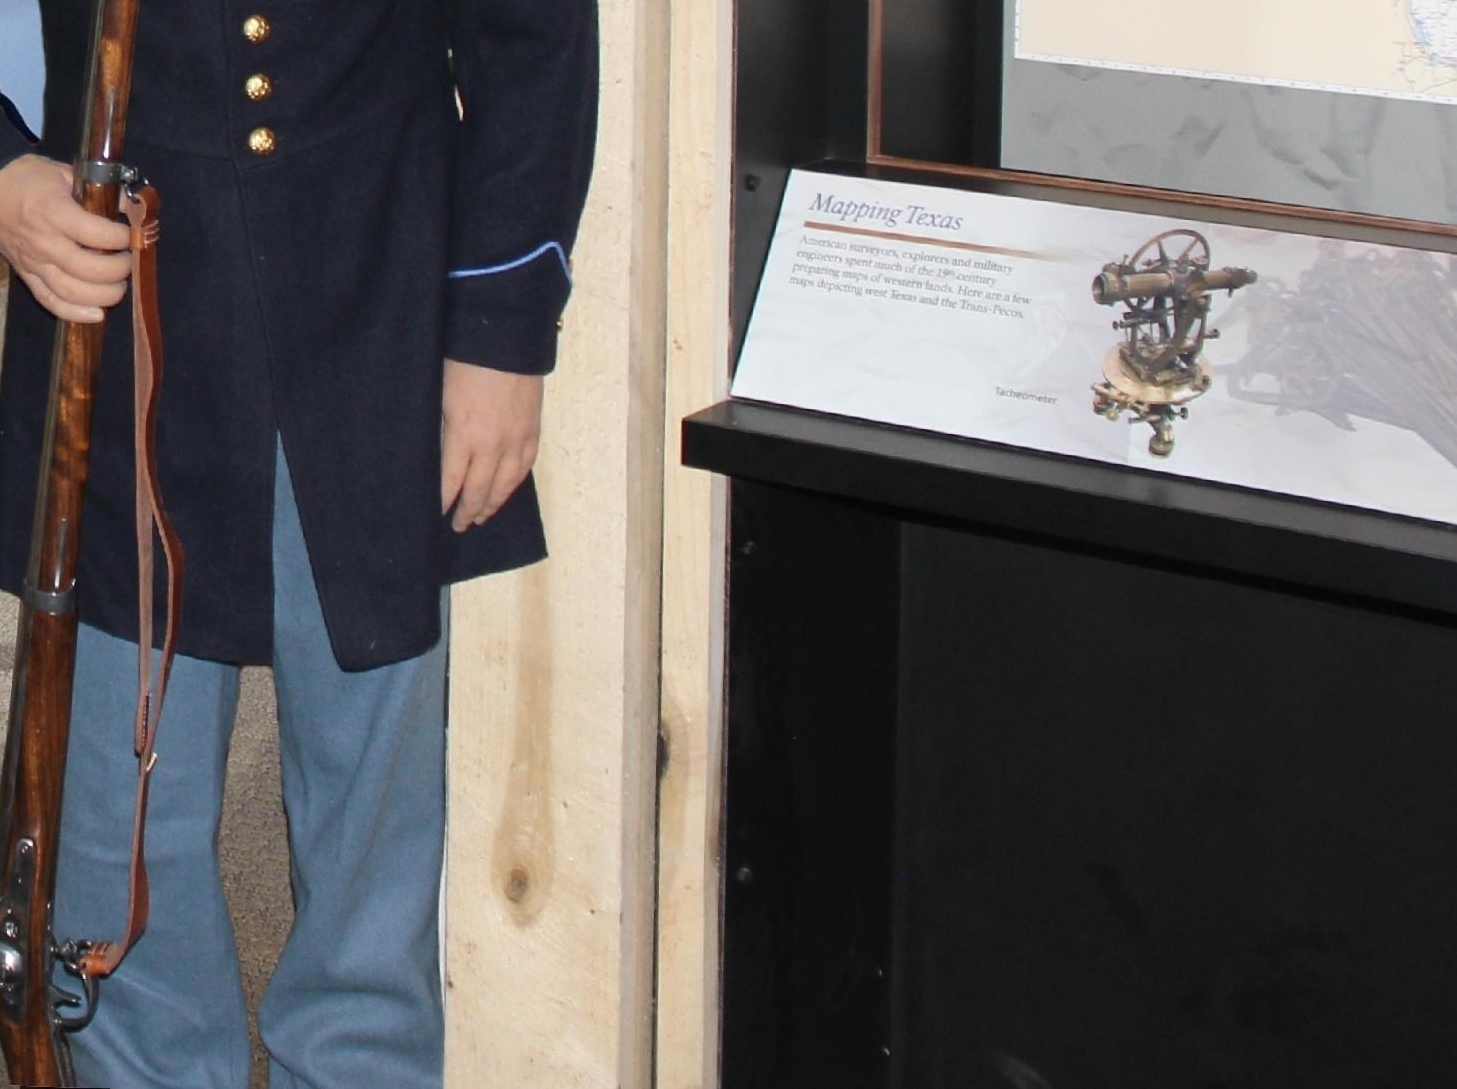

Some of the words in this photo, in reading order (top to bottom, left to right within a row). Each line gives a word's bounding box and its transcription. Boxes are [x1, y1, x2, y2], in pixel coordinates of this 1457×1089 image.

[809, 192, 903, 228] Mapping
[905, 204, 964, 231] Texas
[796, 251, 844, 267] engineers
[844, 257, 873, 270] spent
[873, 259, 903, 273] much
[904, 263, 916, 275] of
[917, 265, 935, 277] the
[956, 272, 998, 288] century
[799, 234, 848, 251] American
[848, 242, 900, 259] surveyors,
[901, 250, 950, 266] explorers
[951, 257, 972, 269] and
[973, 259, 1014, 276] military
[789, 277, 815, 291] maps
[816, 278, 864, 297] depicting
[864, 287, 888, 299] west
[889, 288, 918, 303] Texas
[918, 295, 940, 306] and
[940, 297, 958, 309] the
[791, 263, 841, 280] preparing
[841, 270, 869, 284] maps
[870, 273, 883, 285] of
[883, 277, 923, 290] western
[925, 280, 954, 294] lands.
[957, 285, 984, 299] Here
[985, 291, 1003, 302] are
[1012, 293, 1032, 306] few
[994, 386, 1059, 406] Tacheometer
